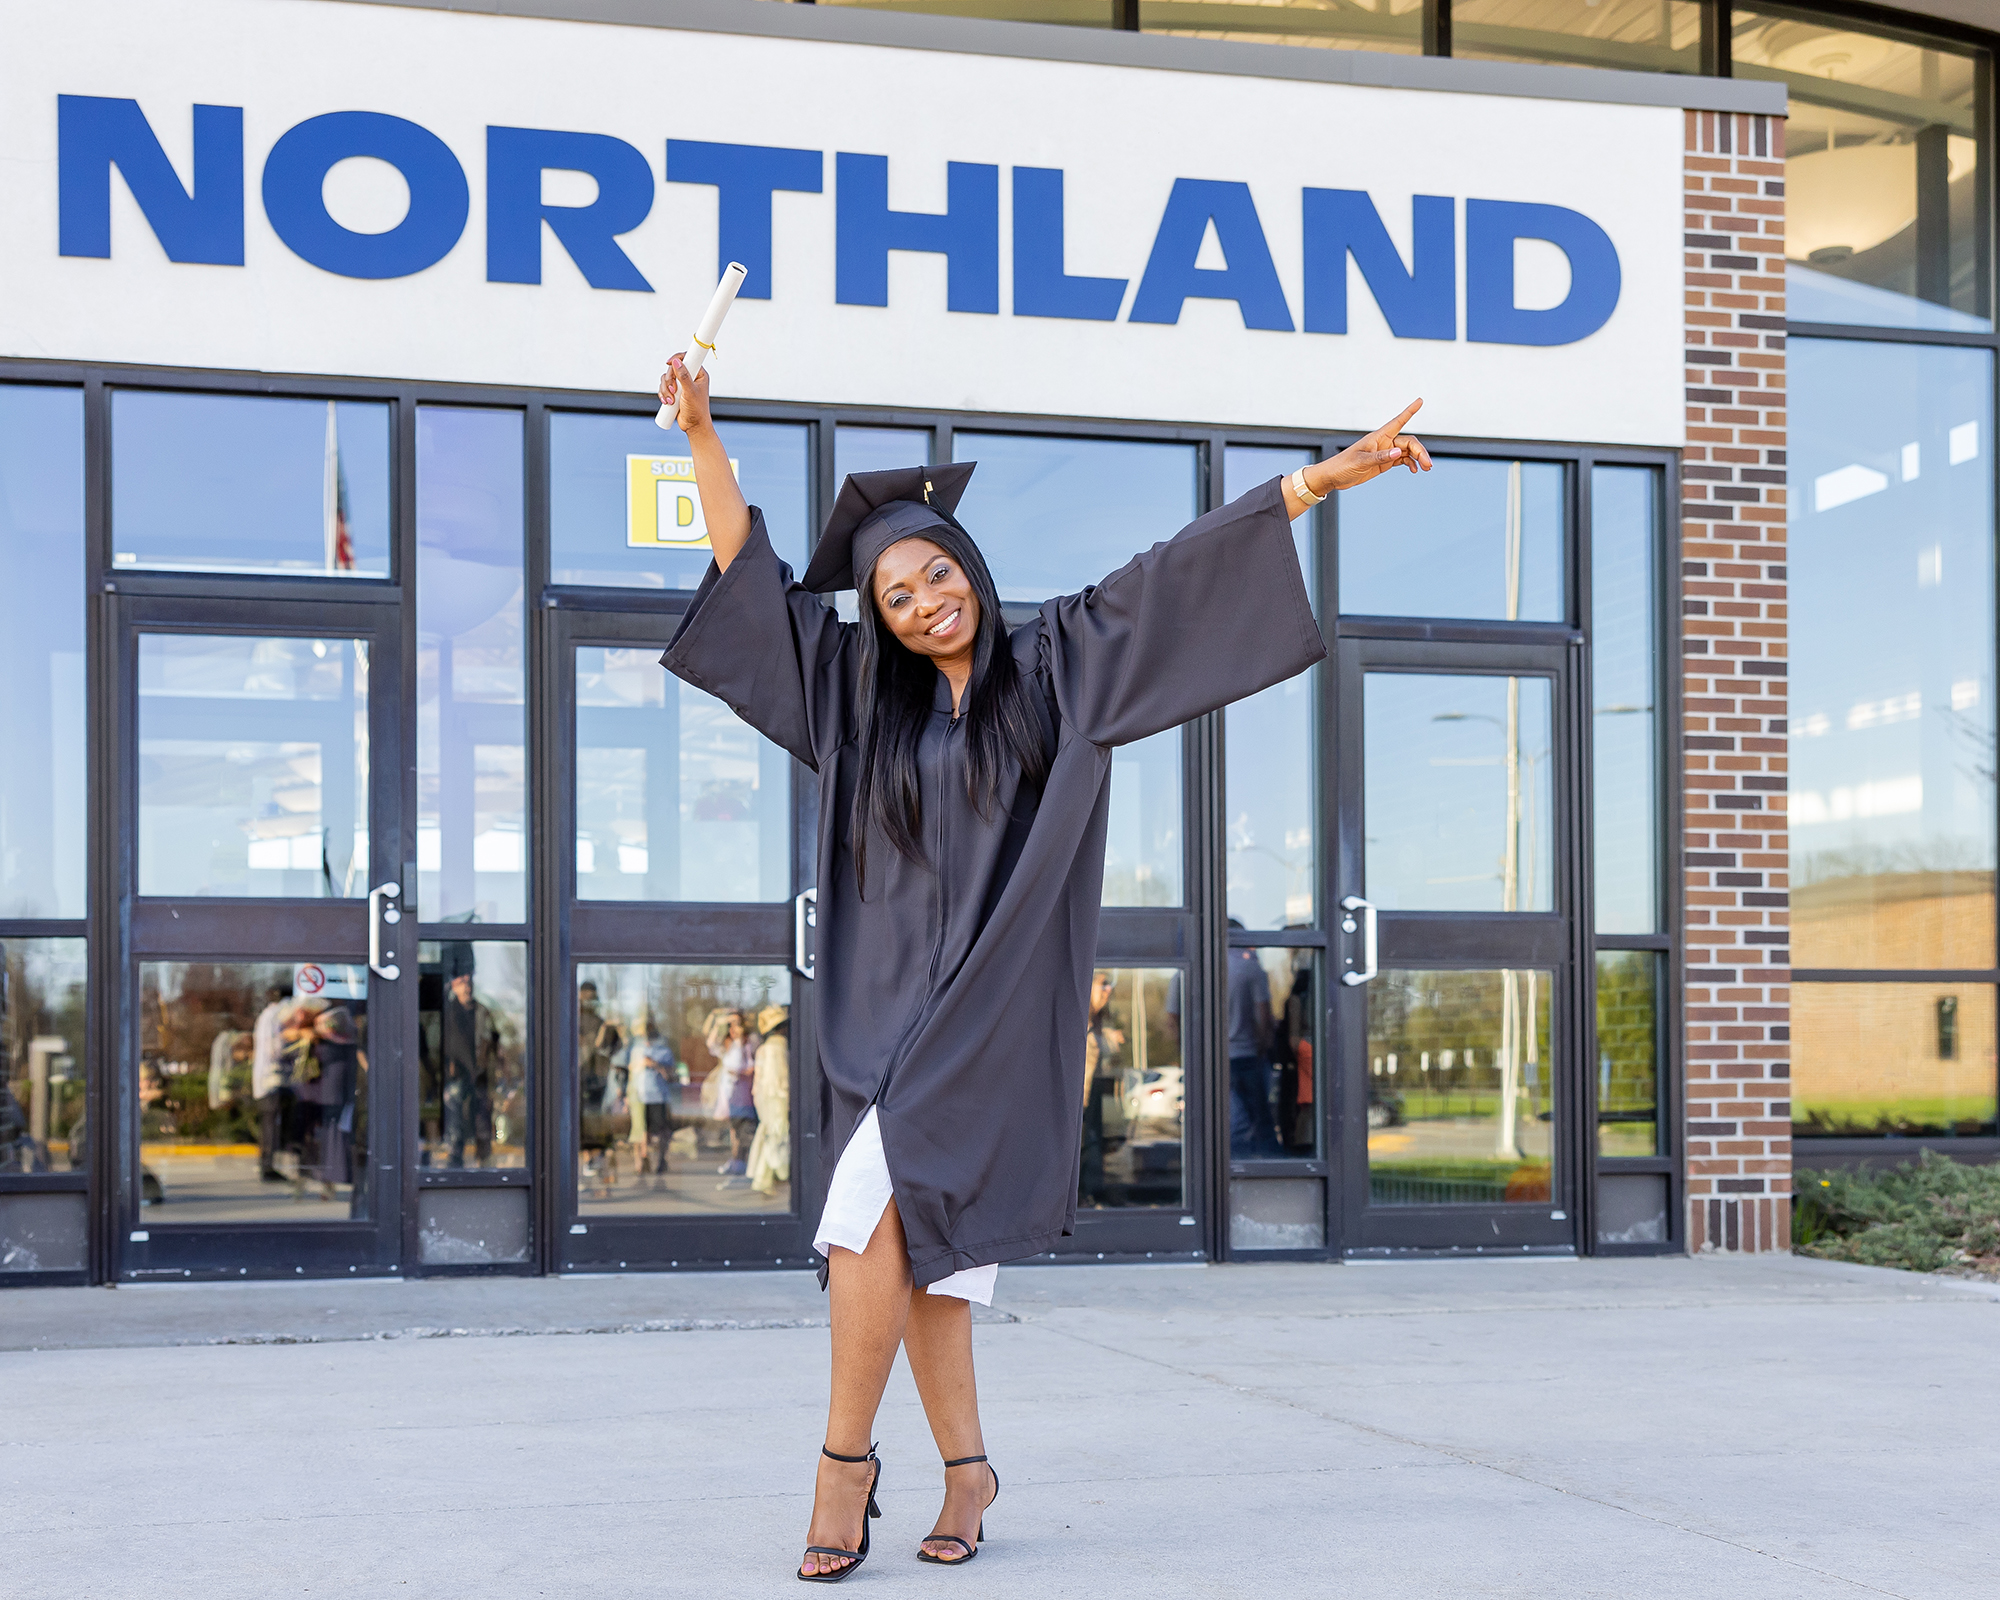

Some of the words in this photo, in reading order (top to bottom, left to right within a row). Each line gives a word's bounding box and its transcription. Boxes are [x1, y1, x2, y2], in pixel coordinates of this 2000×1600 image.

[58, 94, 1621, 347] NORTHLAND
[651, 460, 694, 477] SOU
[656, 479, 708, 542] D
